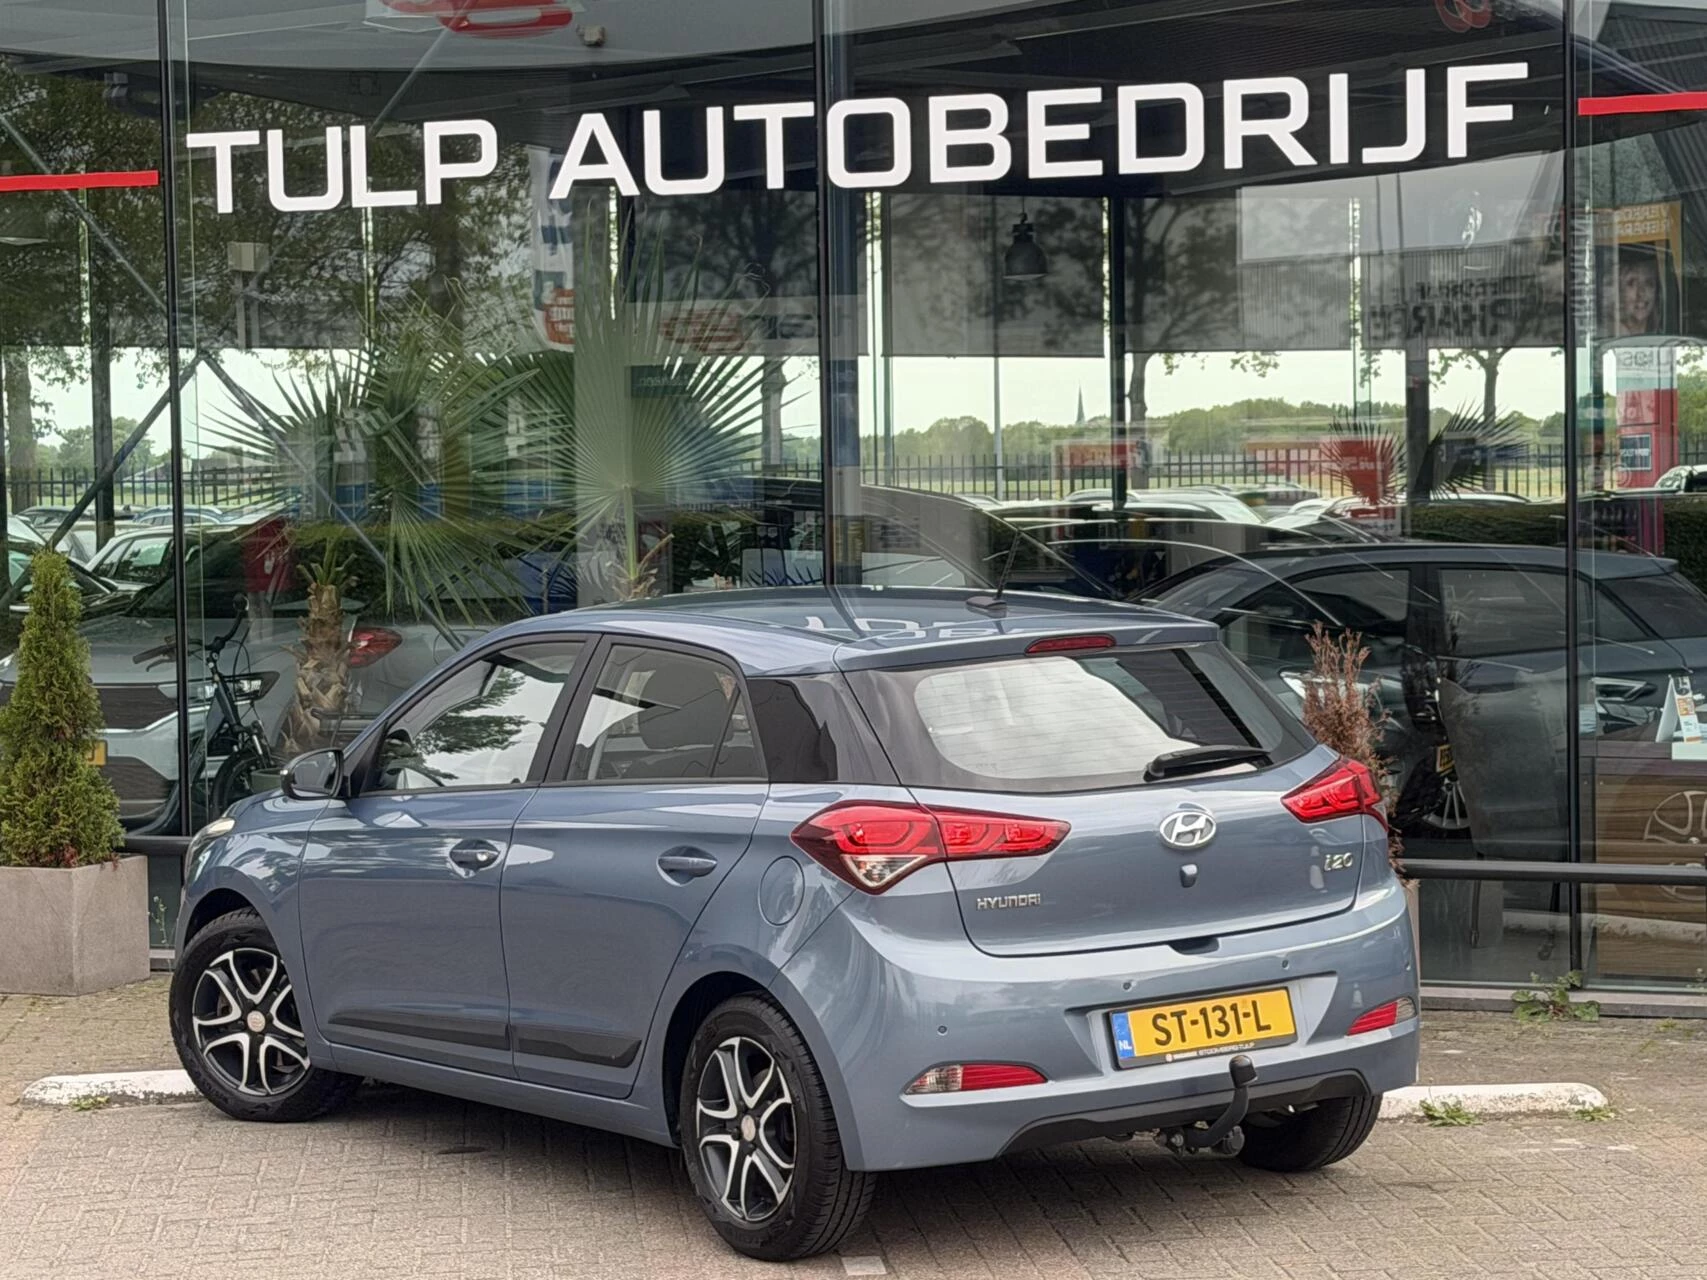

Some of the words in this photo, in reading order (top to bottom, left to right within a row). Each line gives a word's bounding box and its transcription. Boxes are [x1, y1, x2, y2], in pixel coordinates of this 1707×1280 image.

[186, 118, 499, 215] TULP
[549, 61, 1529, 201] AUTOBEDRIJF
[1324, 852, 1353, 872] i20
[976, 892, 1041, 910] HYUNDAI
[1151, 999, 1272, 1047] ST-131-L
[1118, 1039, 1133, 1051] NL
